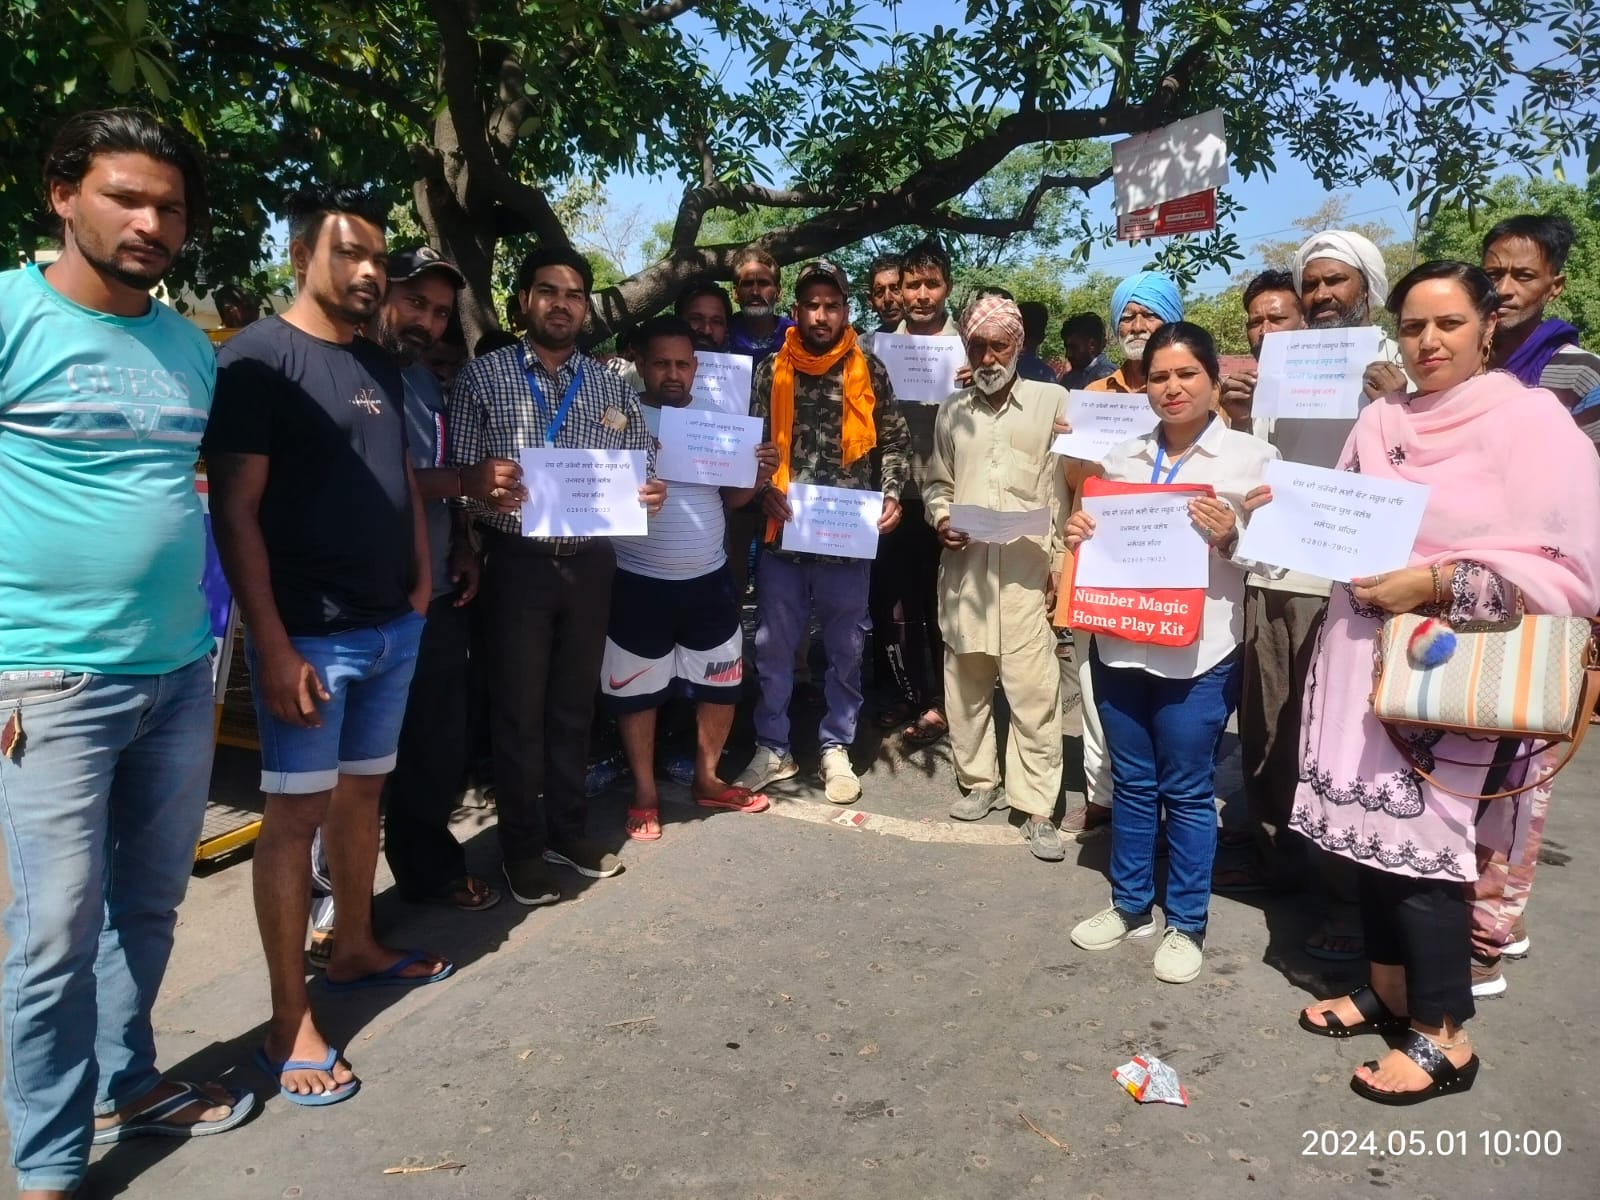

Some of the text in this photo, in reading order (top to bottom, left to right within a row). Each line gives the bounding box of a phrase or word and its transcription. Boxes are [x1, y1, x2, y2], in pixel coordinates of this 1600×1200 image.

[66, 363, 190, 400] GUESS
[1074, 589, 1188, 615] Number Magic
[1073, 610, 1184, 636] Home Play Kit
